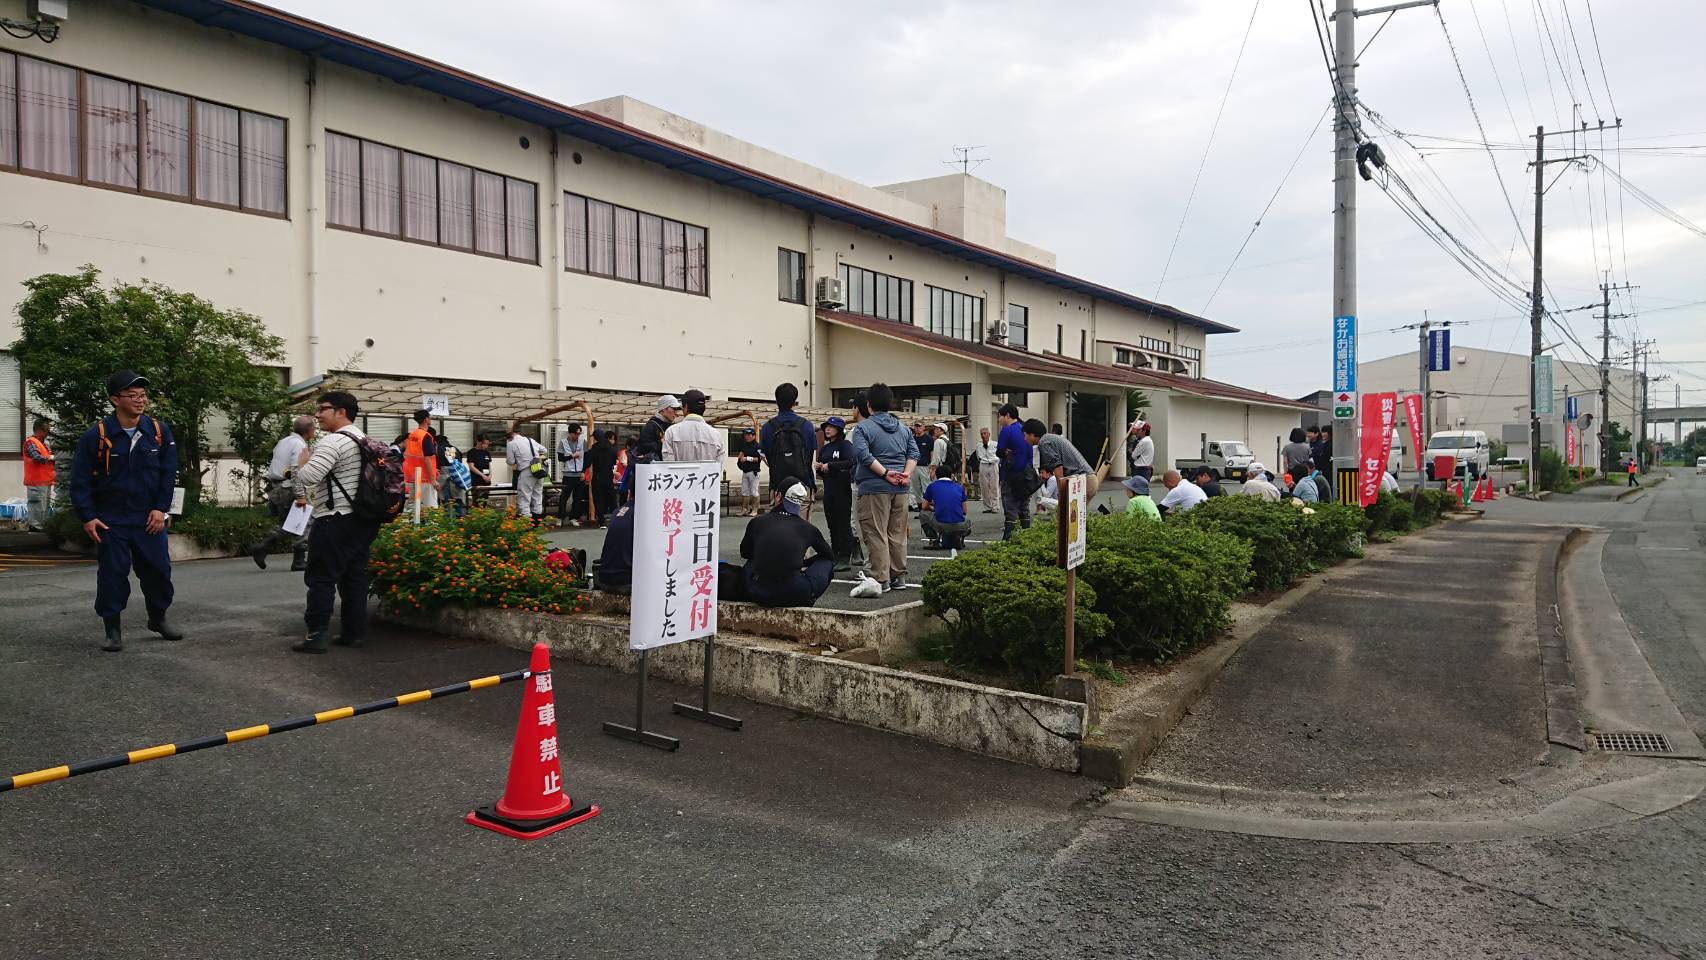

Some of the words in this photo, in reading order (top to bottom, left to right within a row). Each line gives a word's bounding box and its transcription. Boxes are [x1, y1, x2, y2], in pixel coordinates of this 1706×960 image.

[648, 472, 720, 492] ボランティア
[661, 498, 684, 638] 終了しました
[689, 498, 716, 632] 当日受付
[535, 673, 561, 796] 駐車禁止
